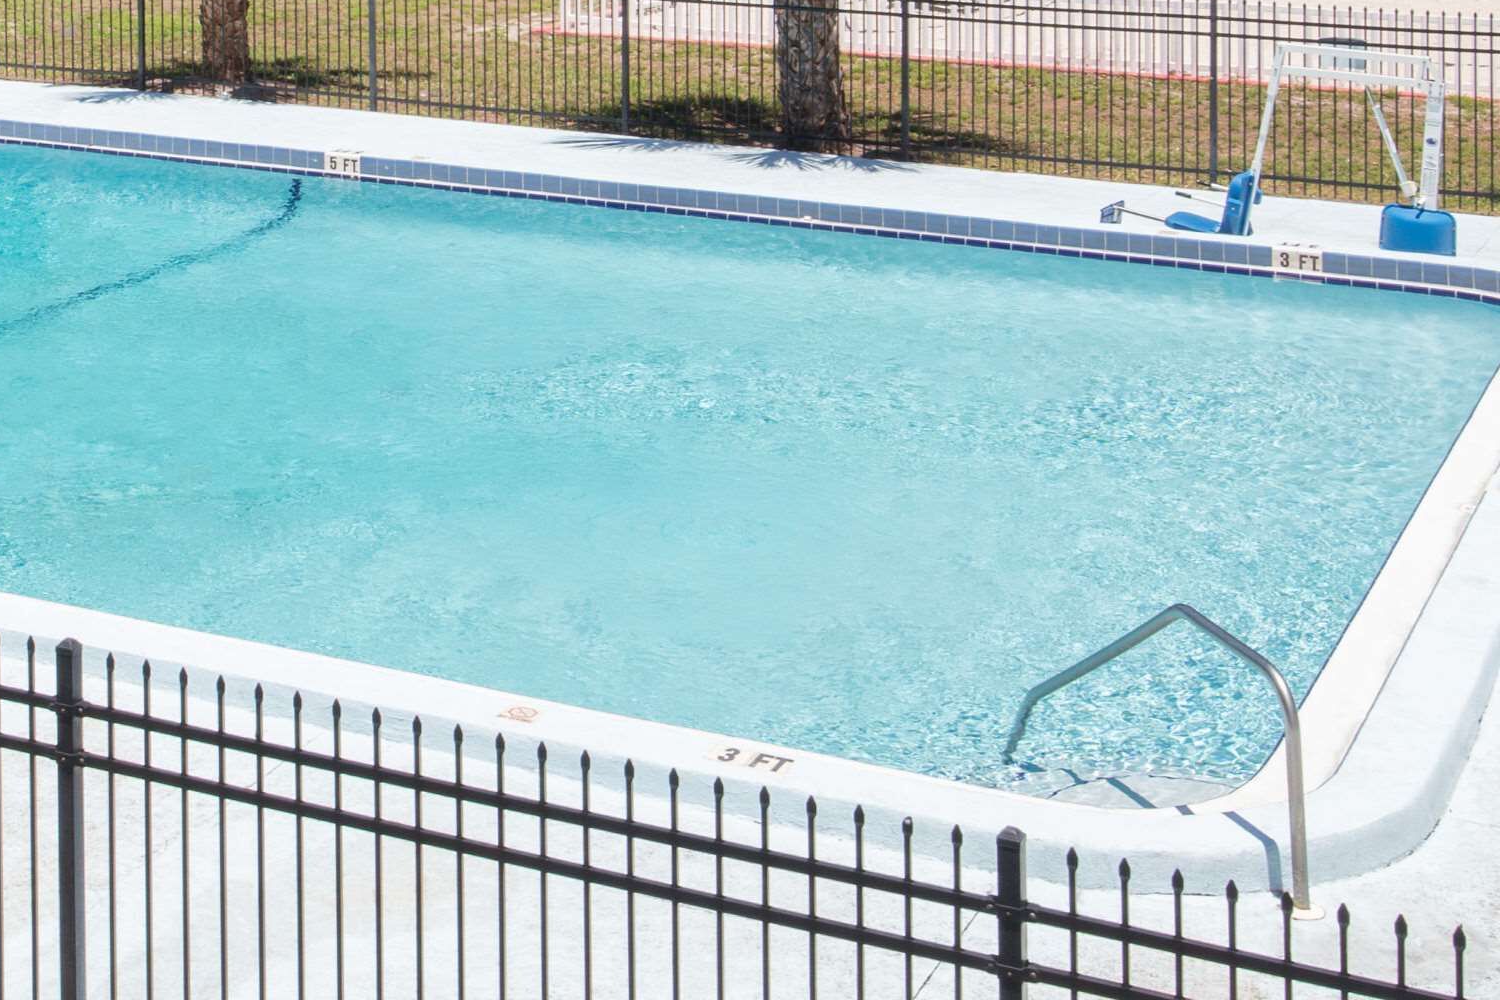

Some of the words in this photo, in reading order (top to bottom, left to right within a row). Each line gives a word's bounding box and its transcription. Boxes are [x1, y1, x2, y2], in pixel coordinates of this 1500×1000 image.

[329, 156, 337, 170] 5
[343, 158, 358, 173] FT
[1280, 252, 1290, 268] 3
[1299, 254, 1320, 272] FT
[717, 747, 741, 762] 3
[748, 753, 795, 772] FT
